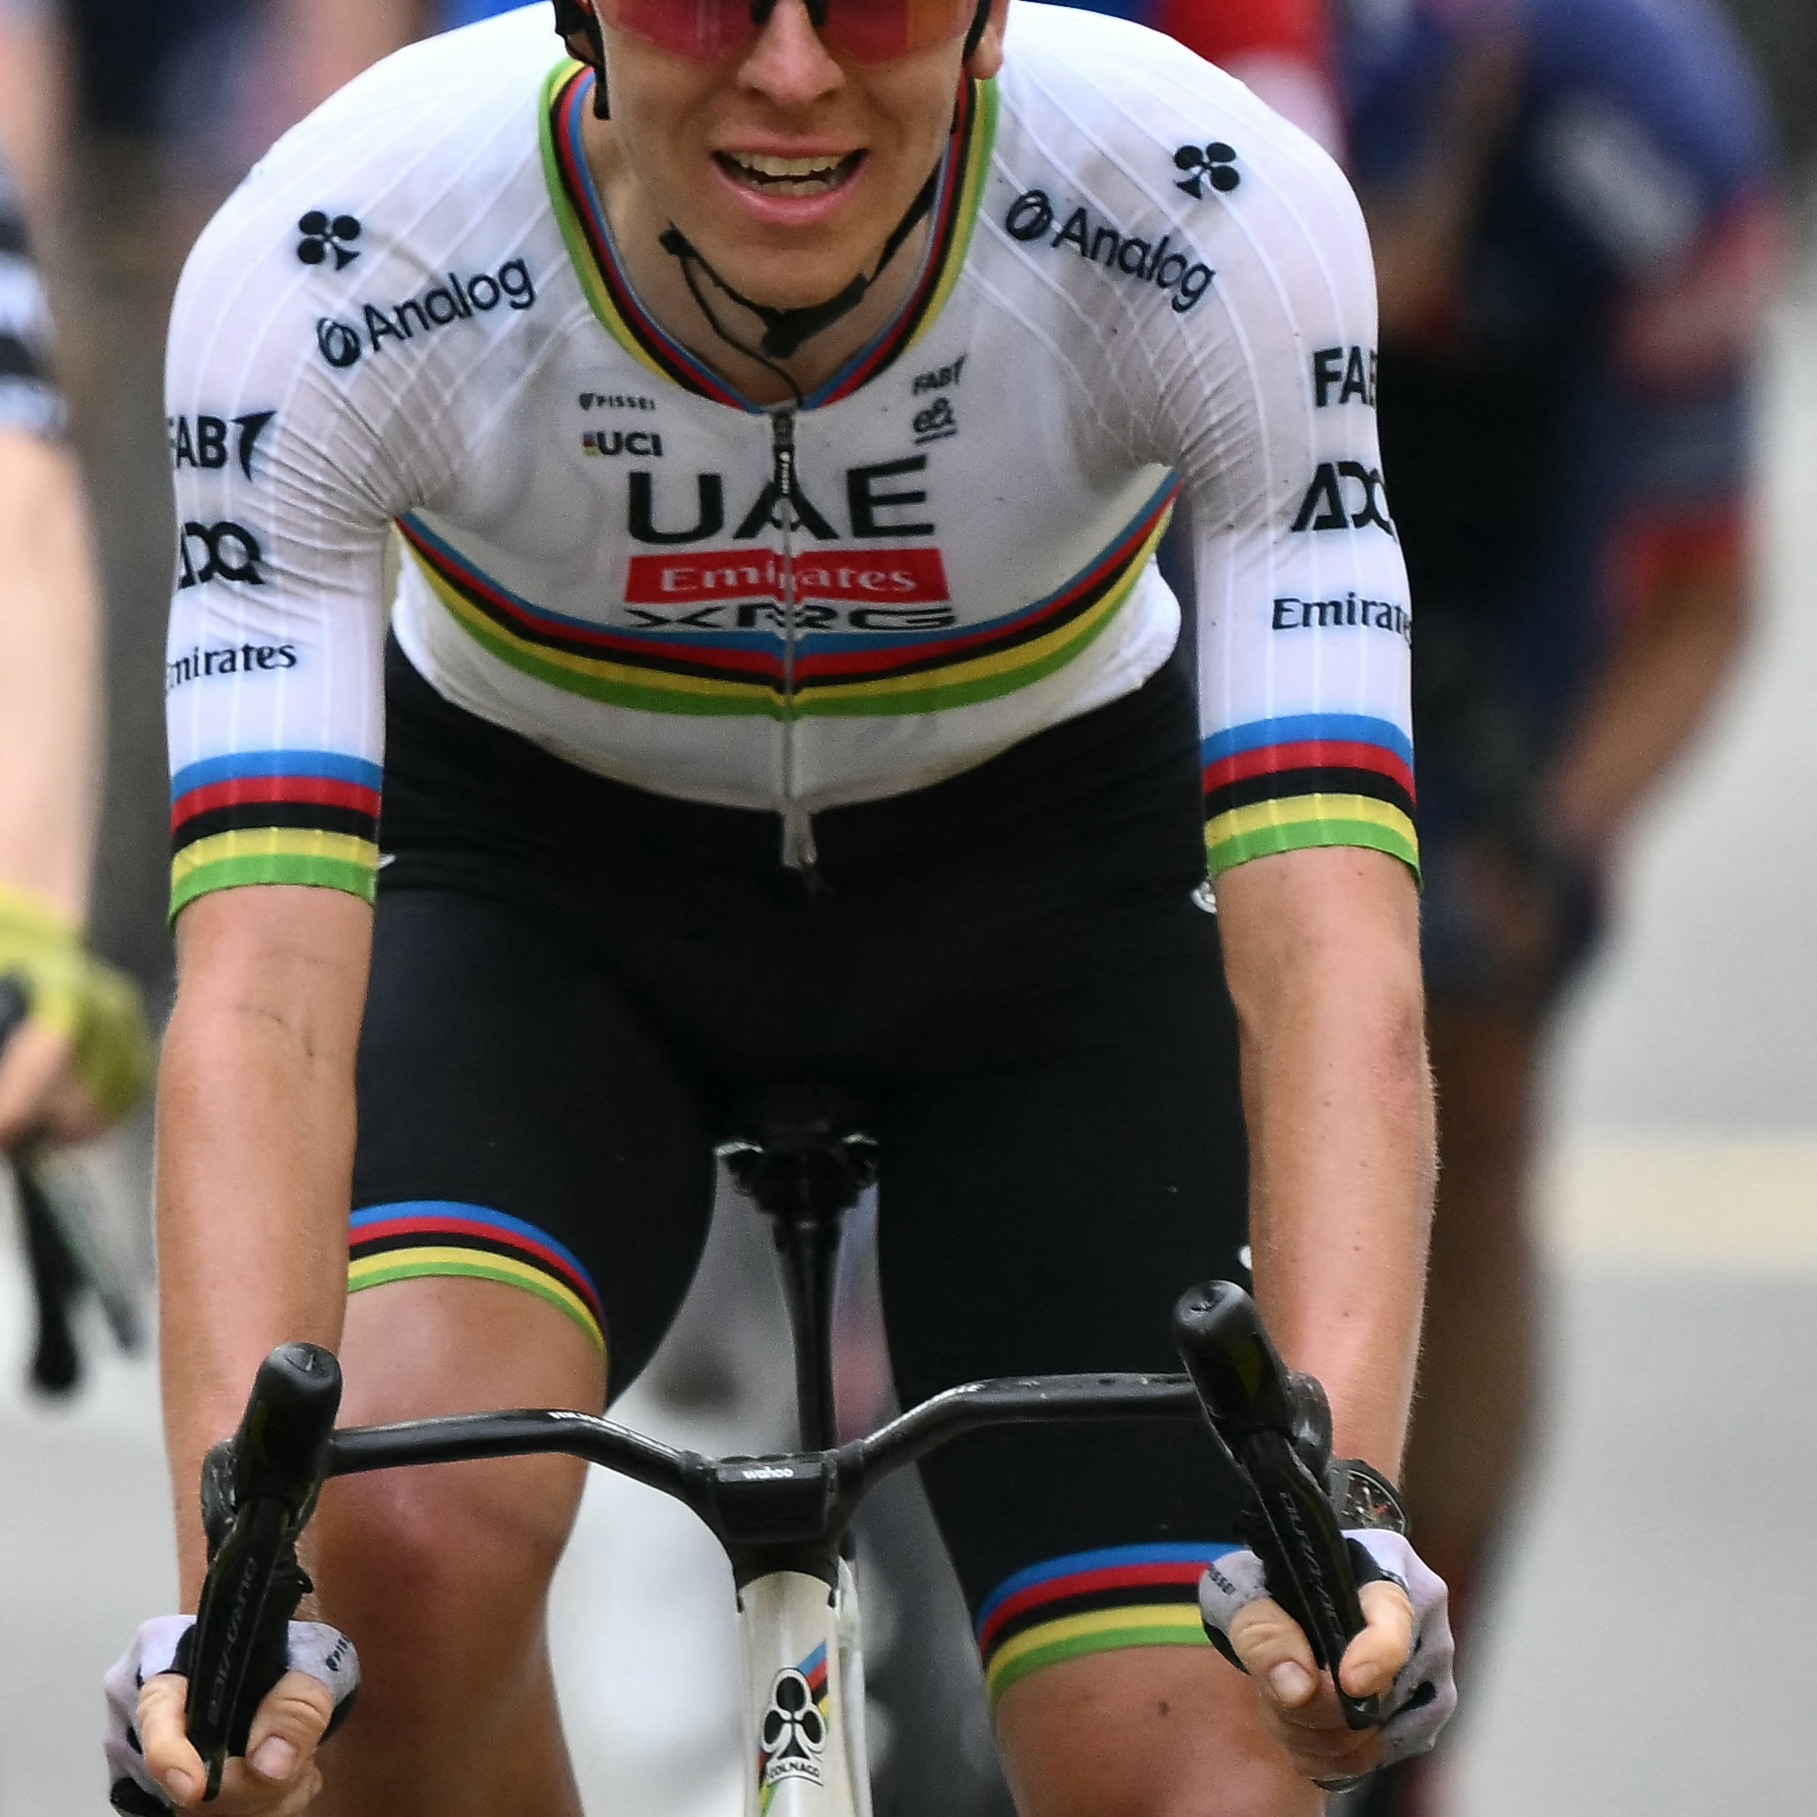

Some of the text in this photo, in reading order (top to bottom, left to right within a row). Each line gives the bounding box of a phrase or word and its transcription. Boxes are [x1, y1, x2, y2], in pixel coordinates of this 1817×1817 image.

[1051, 206, 1216, 313] Analog
[363, 257, 535, 353] Analog
[169, 415, 227, 469] AB
[596, 430, 664, 457] UCI
[628, 454, 935, 545] UAE
[623, 602, 957, 632] XRG
[742, 1466, 795, 1480] wahoo
